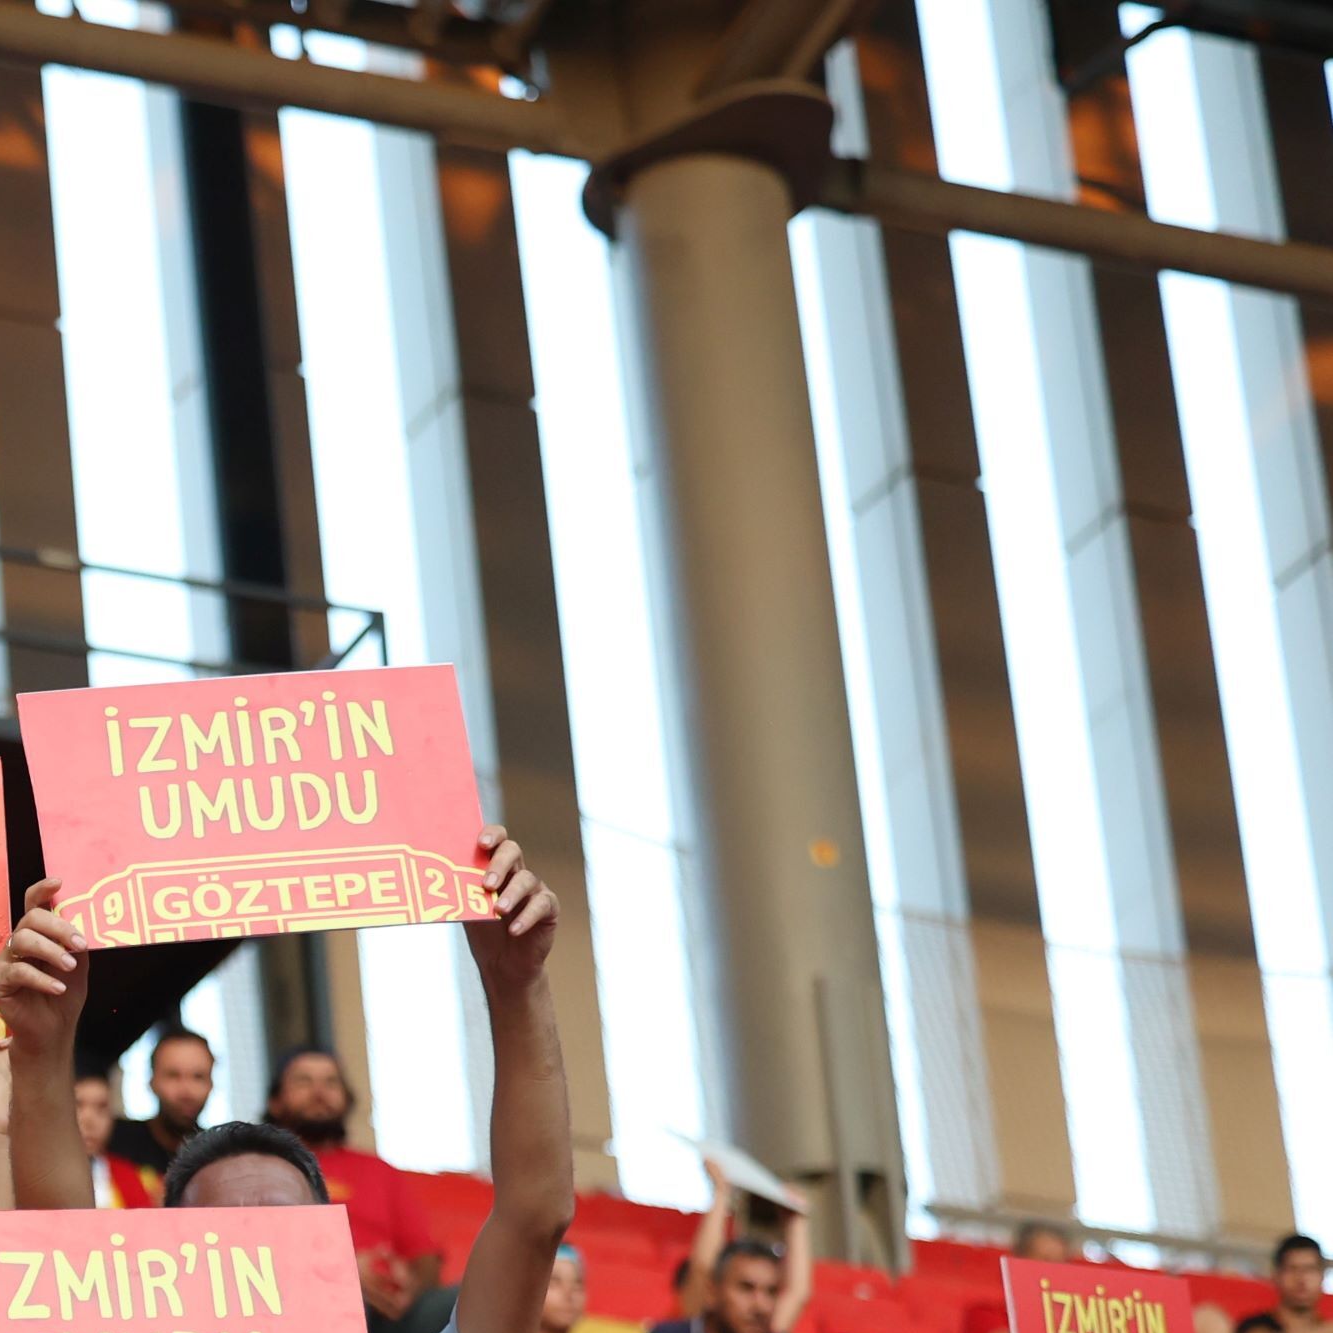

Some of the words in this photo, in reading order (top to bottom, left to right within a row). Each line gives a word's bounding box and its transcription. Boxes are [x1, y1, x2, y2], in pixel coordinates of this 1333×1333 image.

[104, 690, 395, 777] İZMİR'İN
[139, 769, 378, 839] UMUDU
[152, 870, 400, 920] GÖZTEPE
